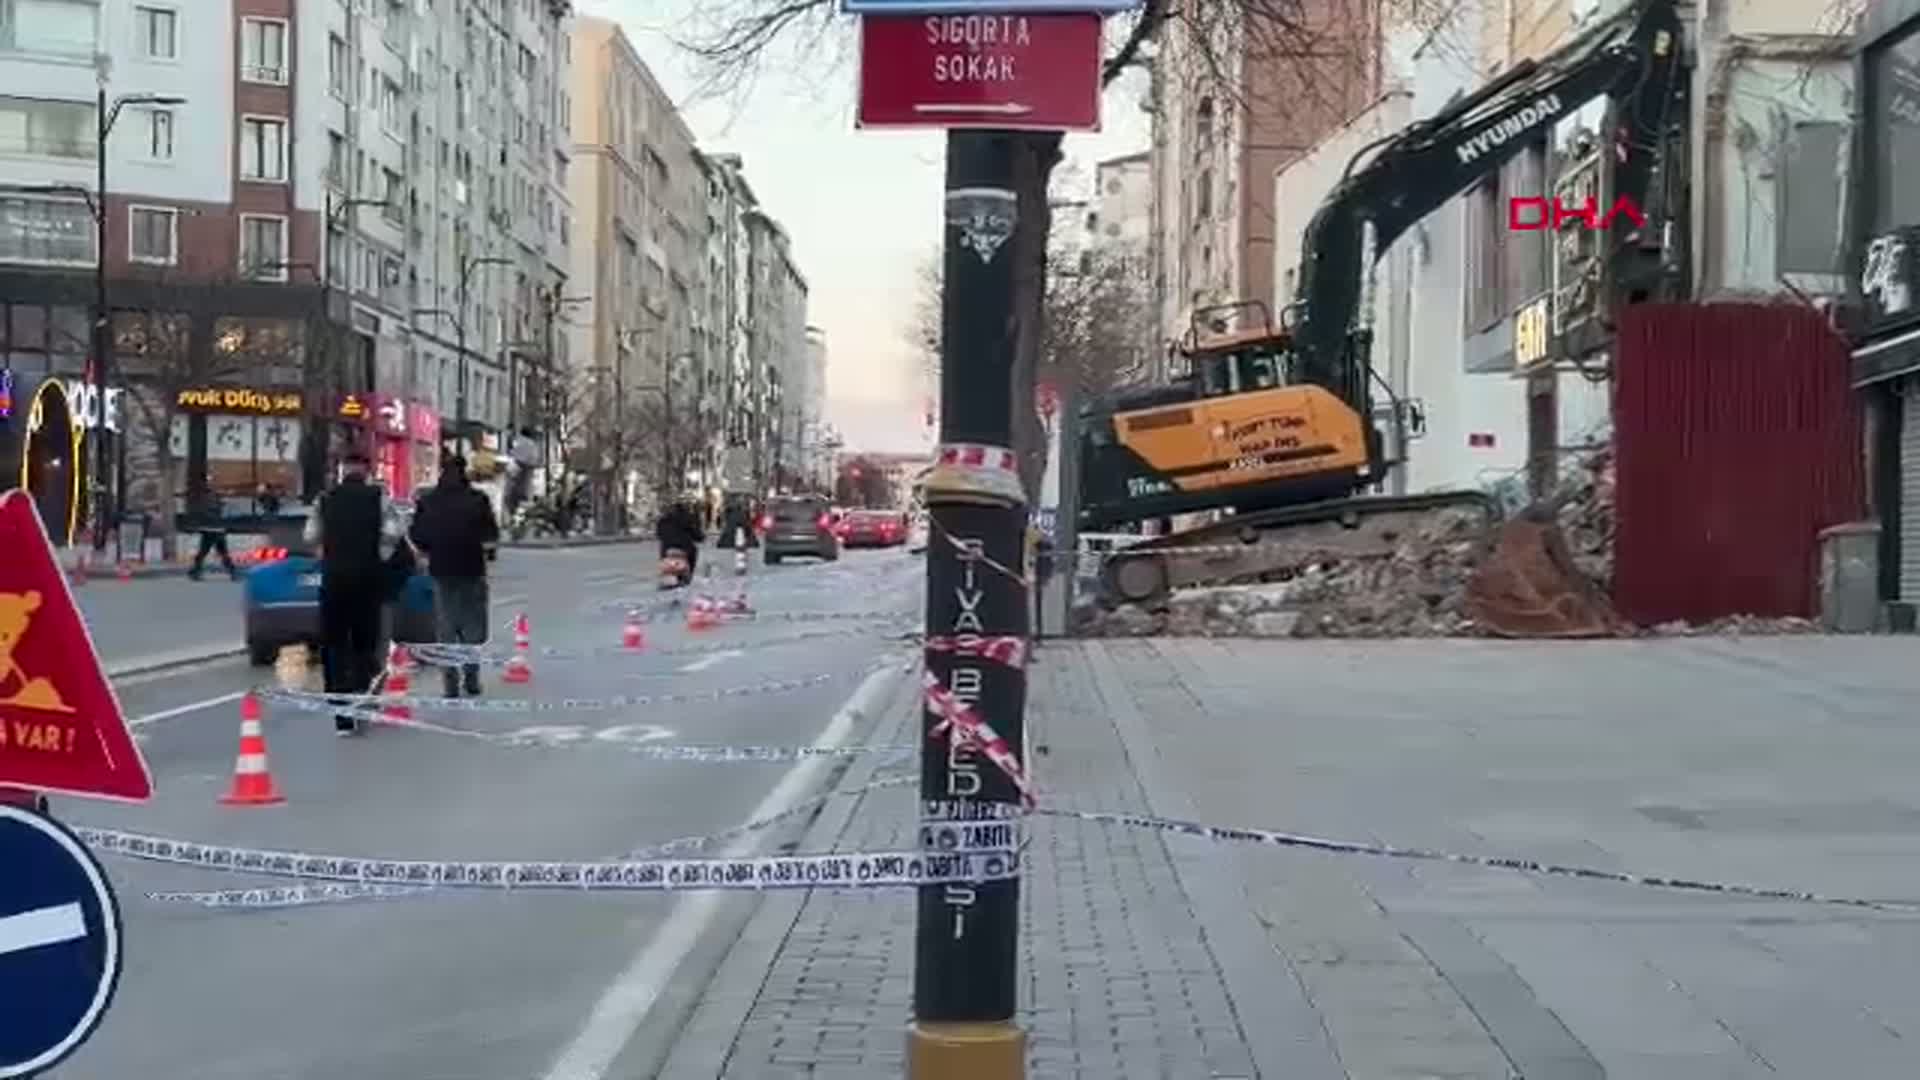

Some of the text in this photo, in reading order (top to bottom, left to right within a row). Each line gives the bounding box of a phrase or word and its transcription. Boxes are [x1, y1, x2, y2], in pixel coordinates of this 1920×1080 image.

[934, 54, 1016, 82] SOKAK
[1456, 94, 1562, 164] HYUNDAI
[13, 721, 61, 751] VAR
